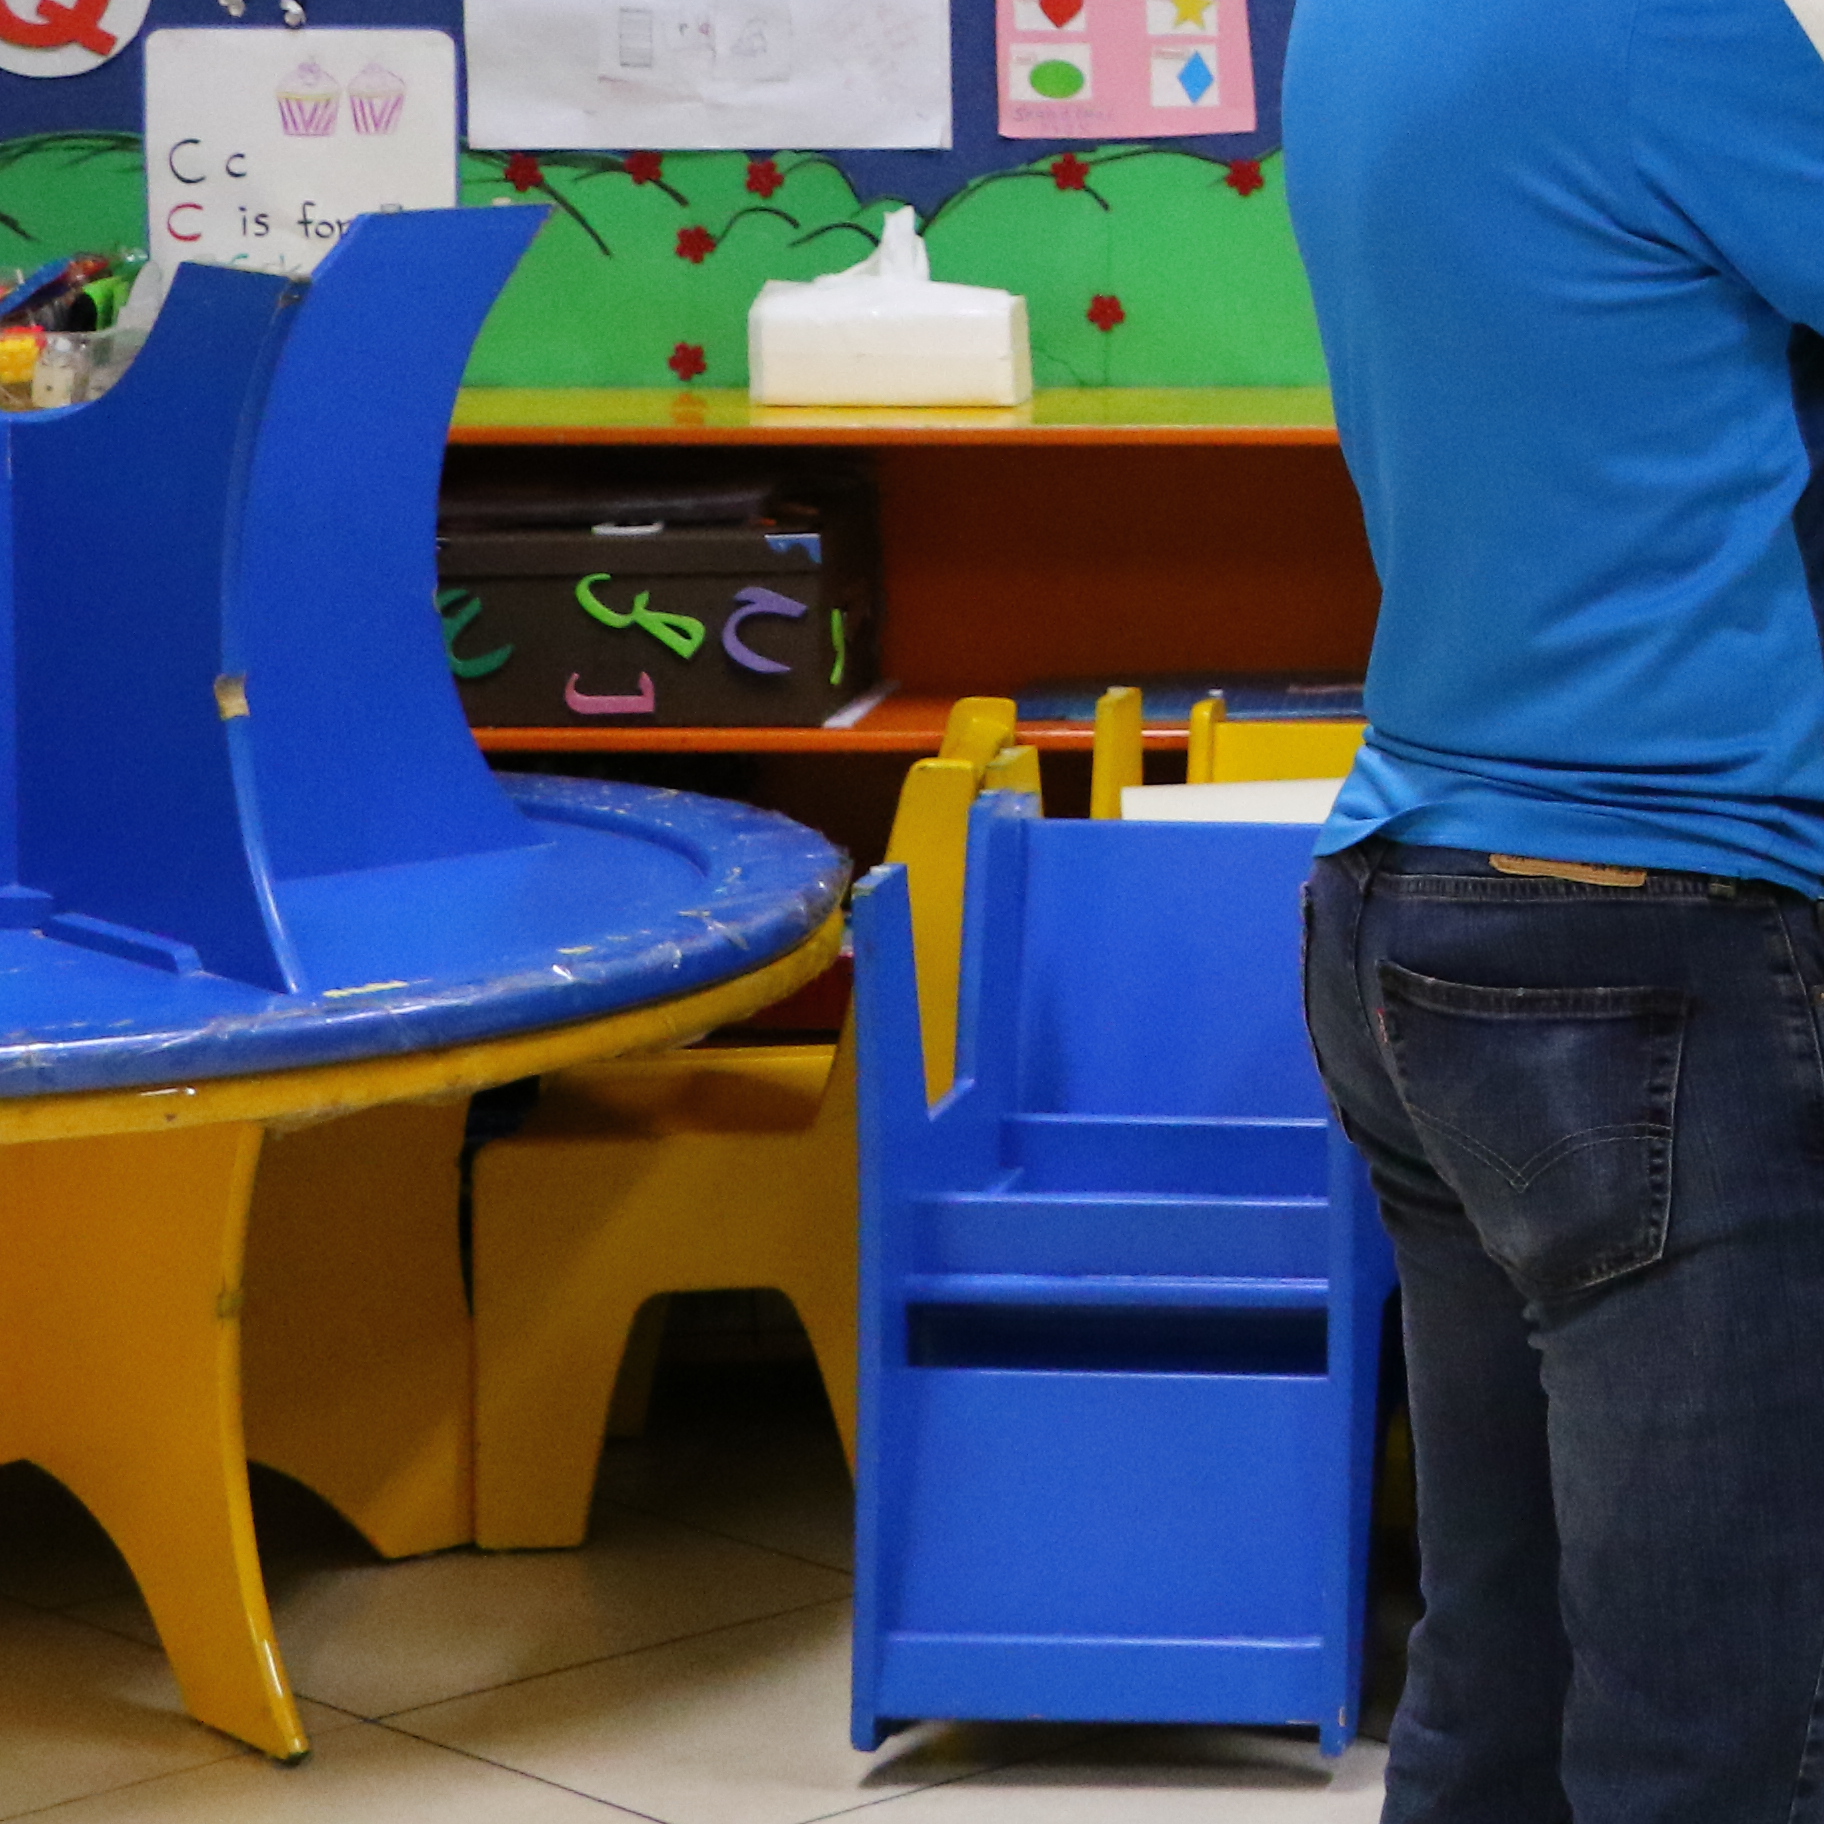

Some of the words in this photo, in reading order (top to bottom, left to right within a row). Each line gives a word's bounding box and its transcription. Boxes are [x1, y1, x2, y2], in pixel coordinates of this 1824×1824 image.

[169, 138, 206, 184] C
[225, 153, 248, 178] c
[167, 203, 204, 242] C
[238, 206, 270, 237] is
[297, 201, 348, 239] for
